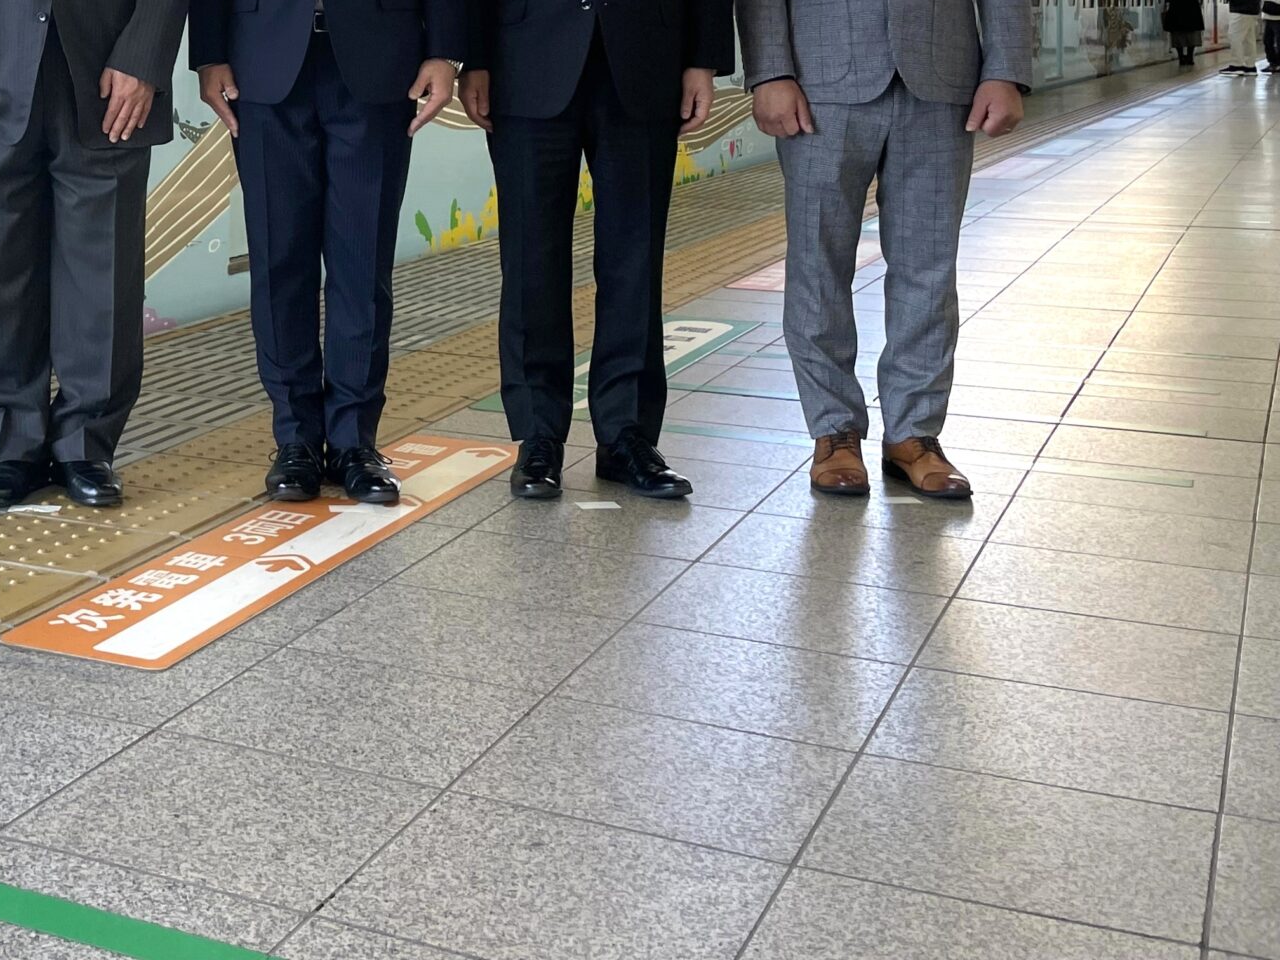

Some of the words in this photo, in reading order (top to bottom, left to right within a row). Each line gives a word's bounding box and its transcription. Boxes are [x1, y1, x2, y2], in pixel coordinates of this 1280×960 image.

[48, 550, 228, 633] 次発電車
[223, 508, 316, 546] 3両目
